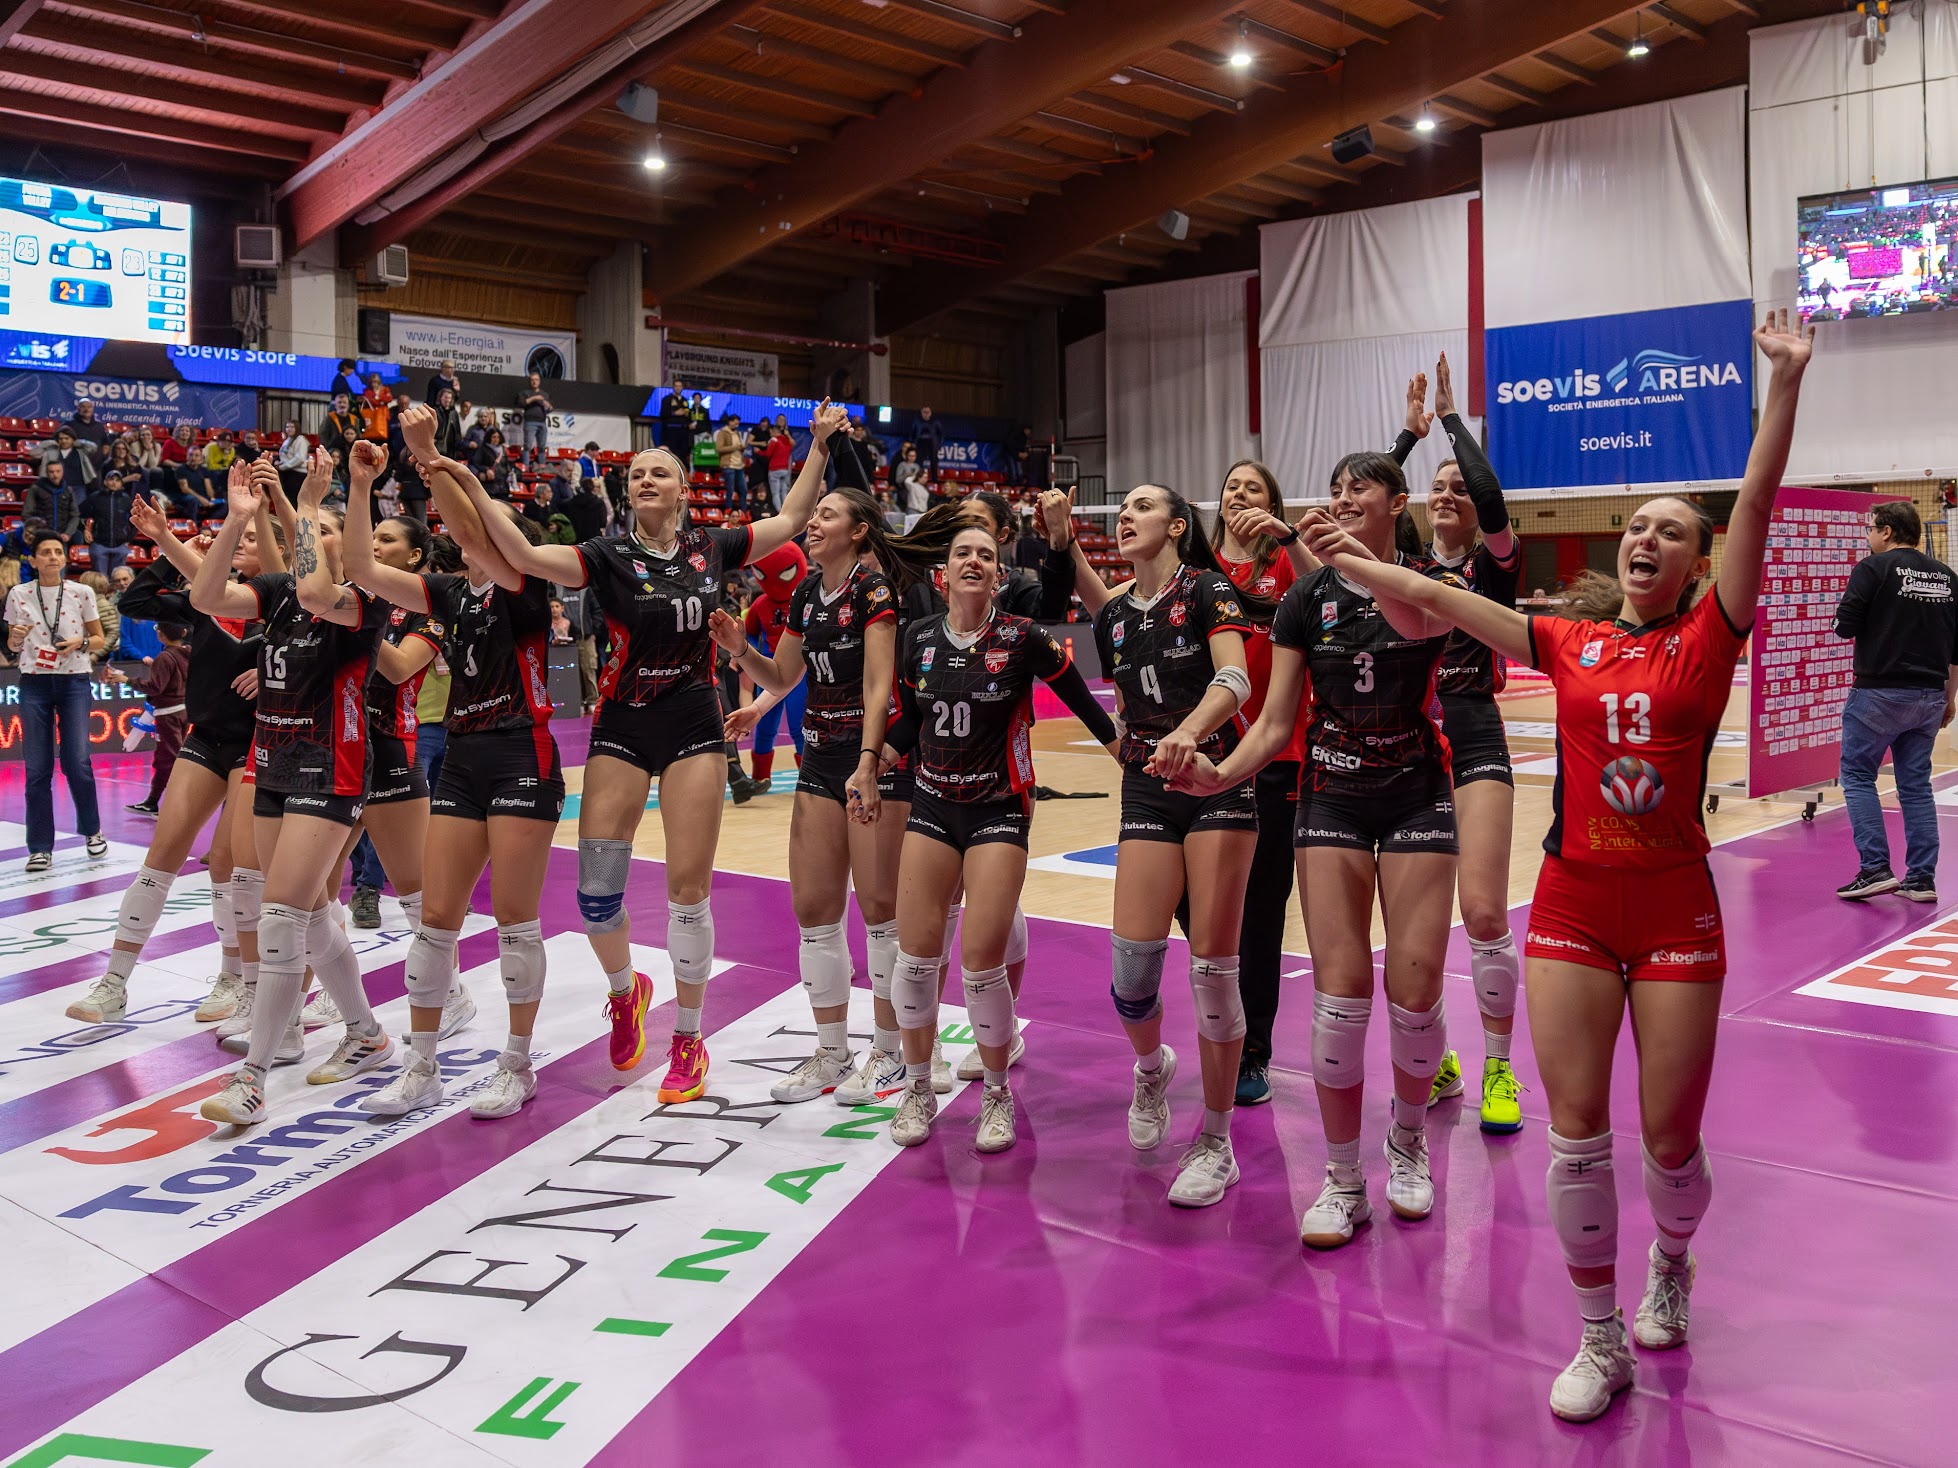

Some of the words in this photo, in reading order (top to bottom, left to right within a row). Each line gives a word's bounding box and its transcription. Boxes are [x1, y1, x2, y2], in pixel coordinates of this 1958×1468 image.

[59, 281, 85, 301] 2-1
[405, 331, 505, 350] www.i-Energia.it
[399, 345, 429, 357] Nasce
[432, 349, 504, 363] dall'Esperienza
[470, 364, 486, 373] per
[74, 380, 160, 401] soevis
[1497, 368, 1600, 404] soevis
[1638, 361, 1743, 393] ARENA
[1548, 400, 1583, 412] SOCIETÀ
[1586, 397, 1641, 409] ENERGETICA
[1643, 393, 1684, 404] ITALIANA
[1580, 430, 1652, 451] soevis.it
[671, 596, 703, 633] 10
[265, 644, 289, 679] 15
[808, 651, 835, 684] 14
[1353, 651, 1375, 693] 3
[1140, 664, 1163, 704] 4
[271, 715, 313, 726] System
[932, 700, 971, 738] 20
[1598, 691, 1652, 744] 13
[949, 771, 998, 785] System
[375, 785, 411, 798] fogliani
[1308, 829, 1358, 840] futurtec
[1409, 830, 1454, 842] fogliani
[1669, 949, 1718, 965] fogliani
[189, 1170, 320, 1229] TORNERIA
[319, 1105, 444, 1171] AUTOMATICA
[474, 1024, 977, 1440] FINANE
